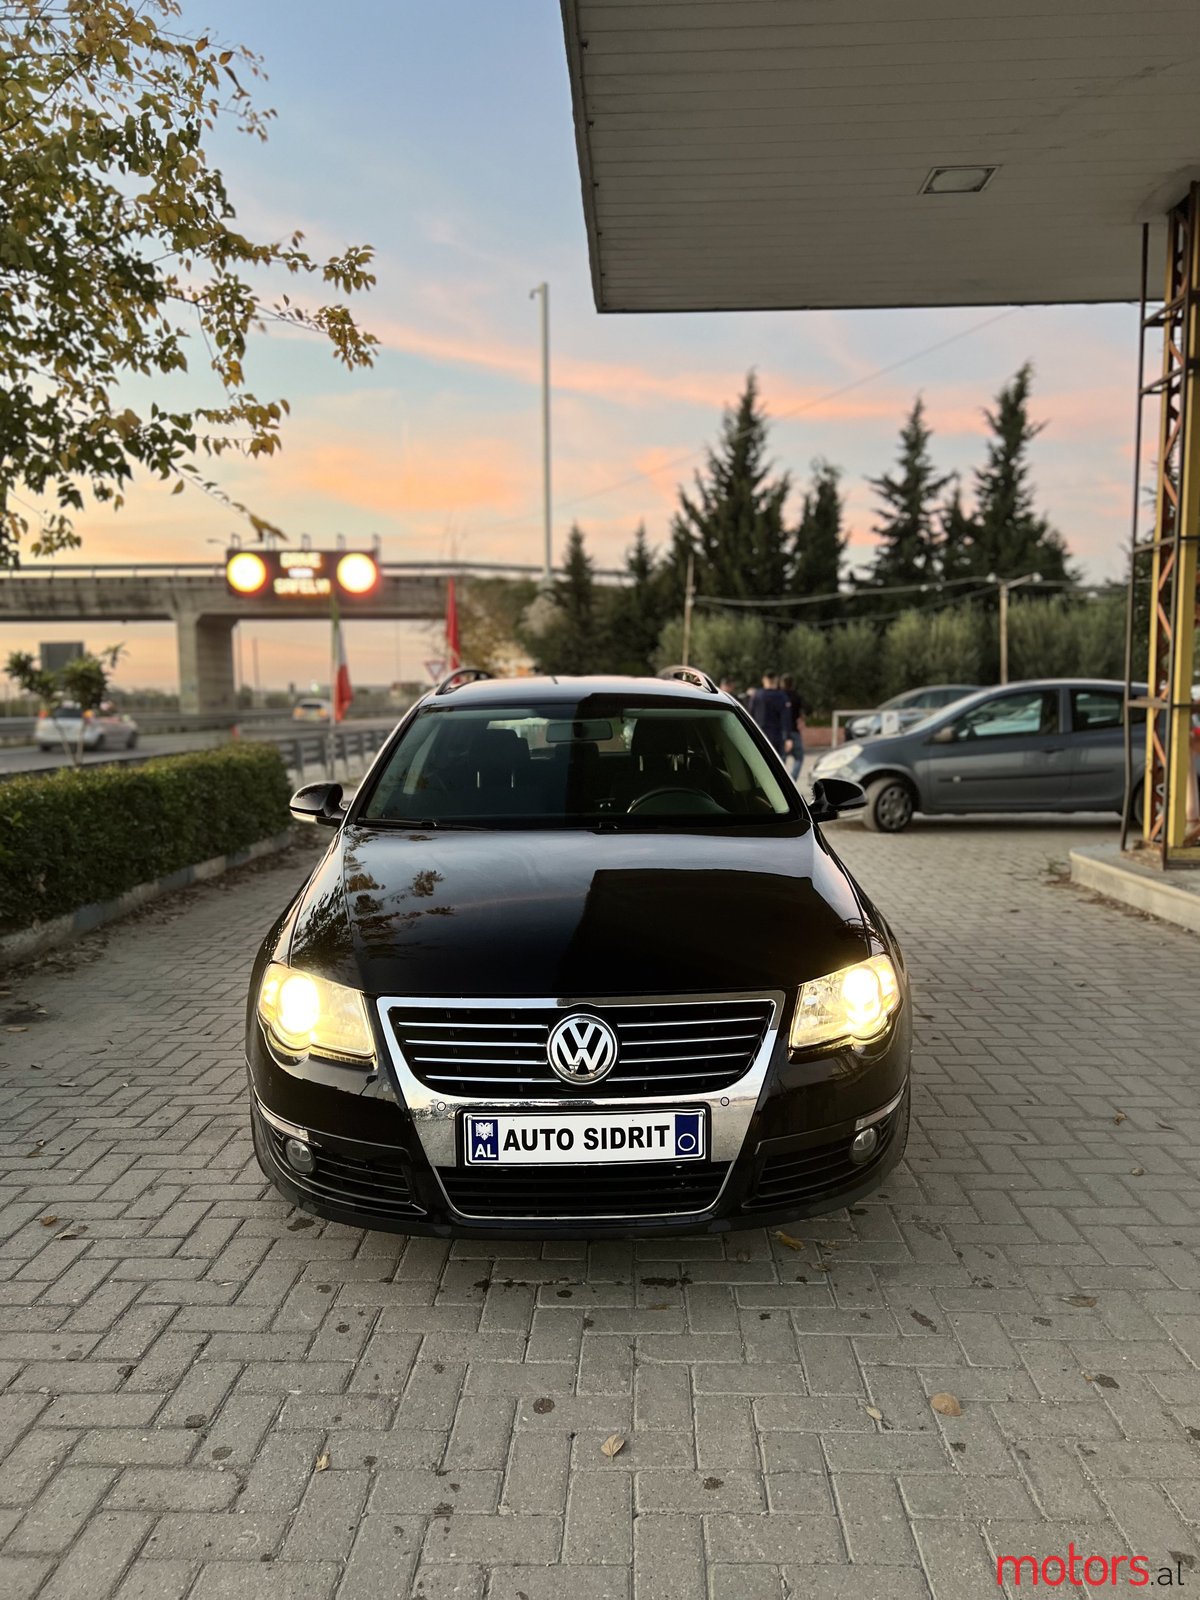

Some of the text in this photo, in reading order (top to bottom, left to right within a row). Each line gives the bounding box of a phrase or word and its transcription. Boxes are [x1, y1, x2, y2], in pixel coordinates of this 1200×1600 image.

[551, 1017, 613, 1080] VW
[474, 1143, 497, 1158] AL
[503, 1125, 670, 1151] AUTO SIDRIT
